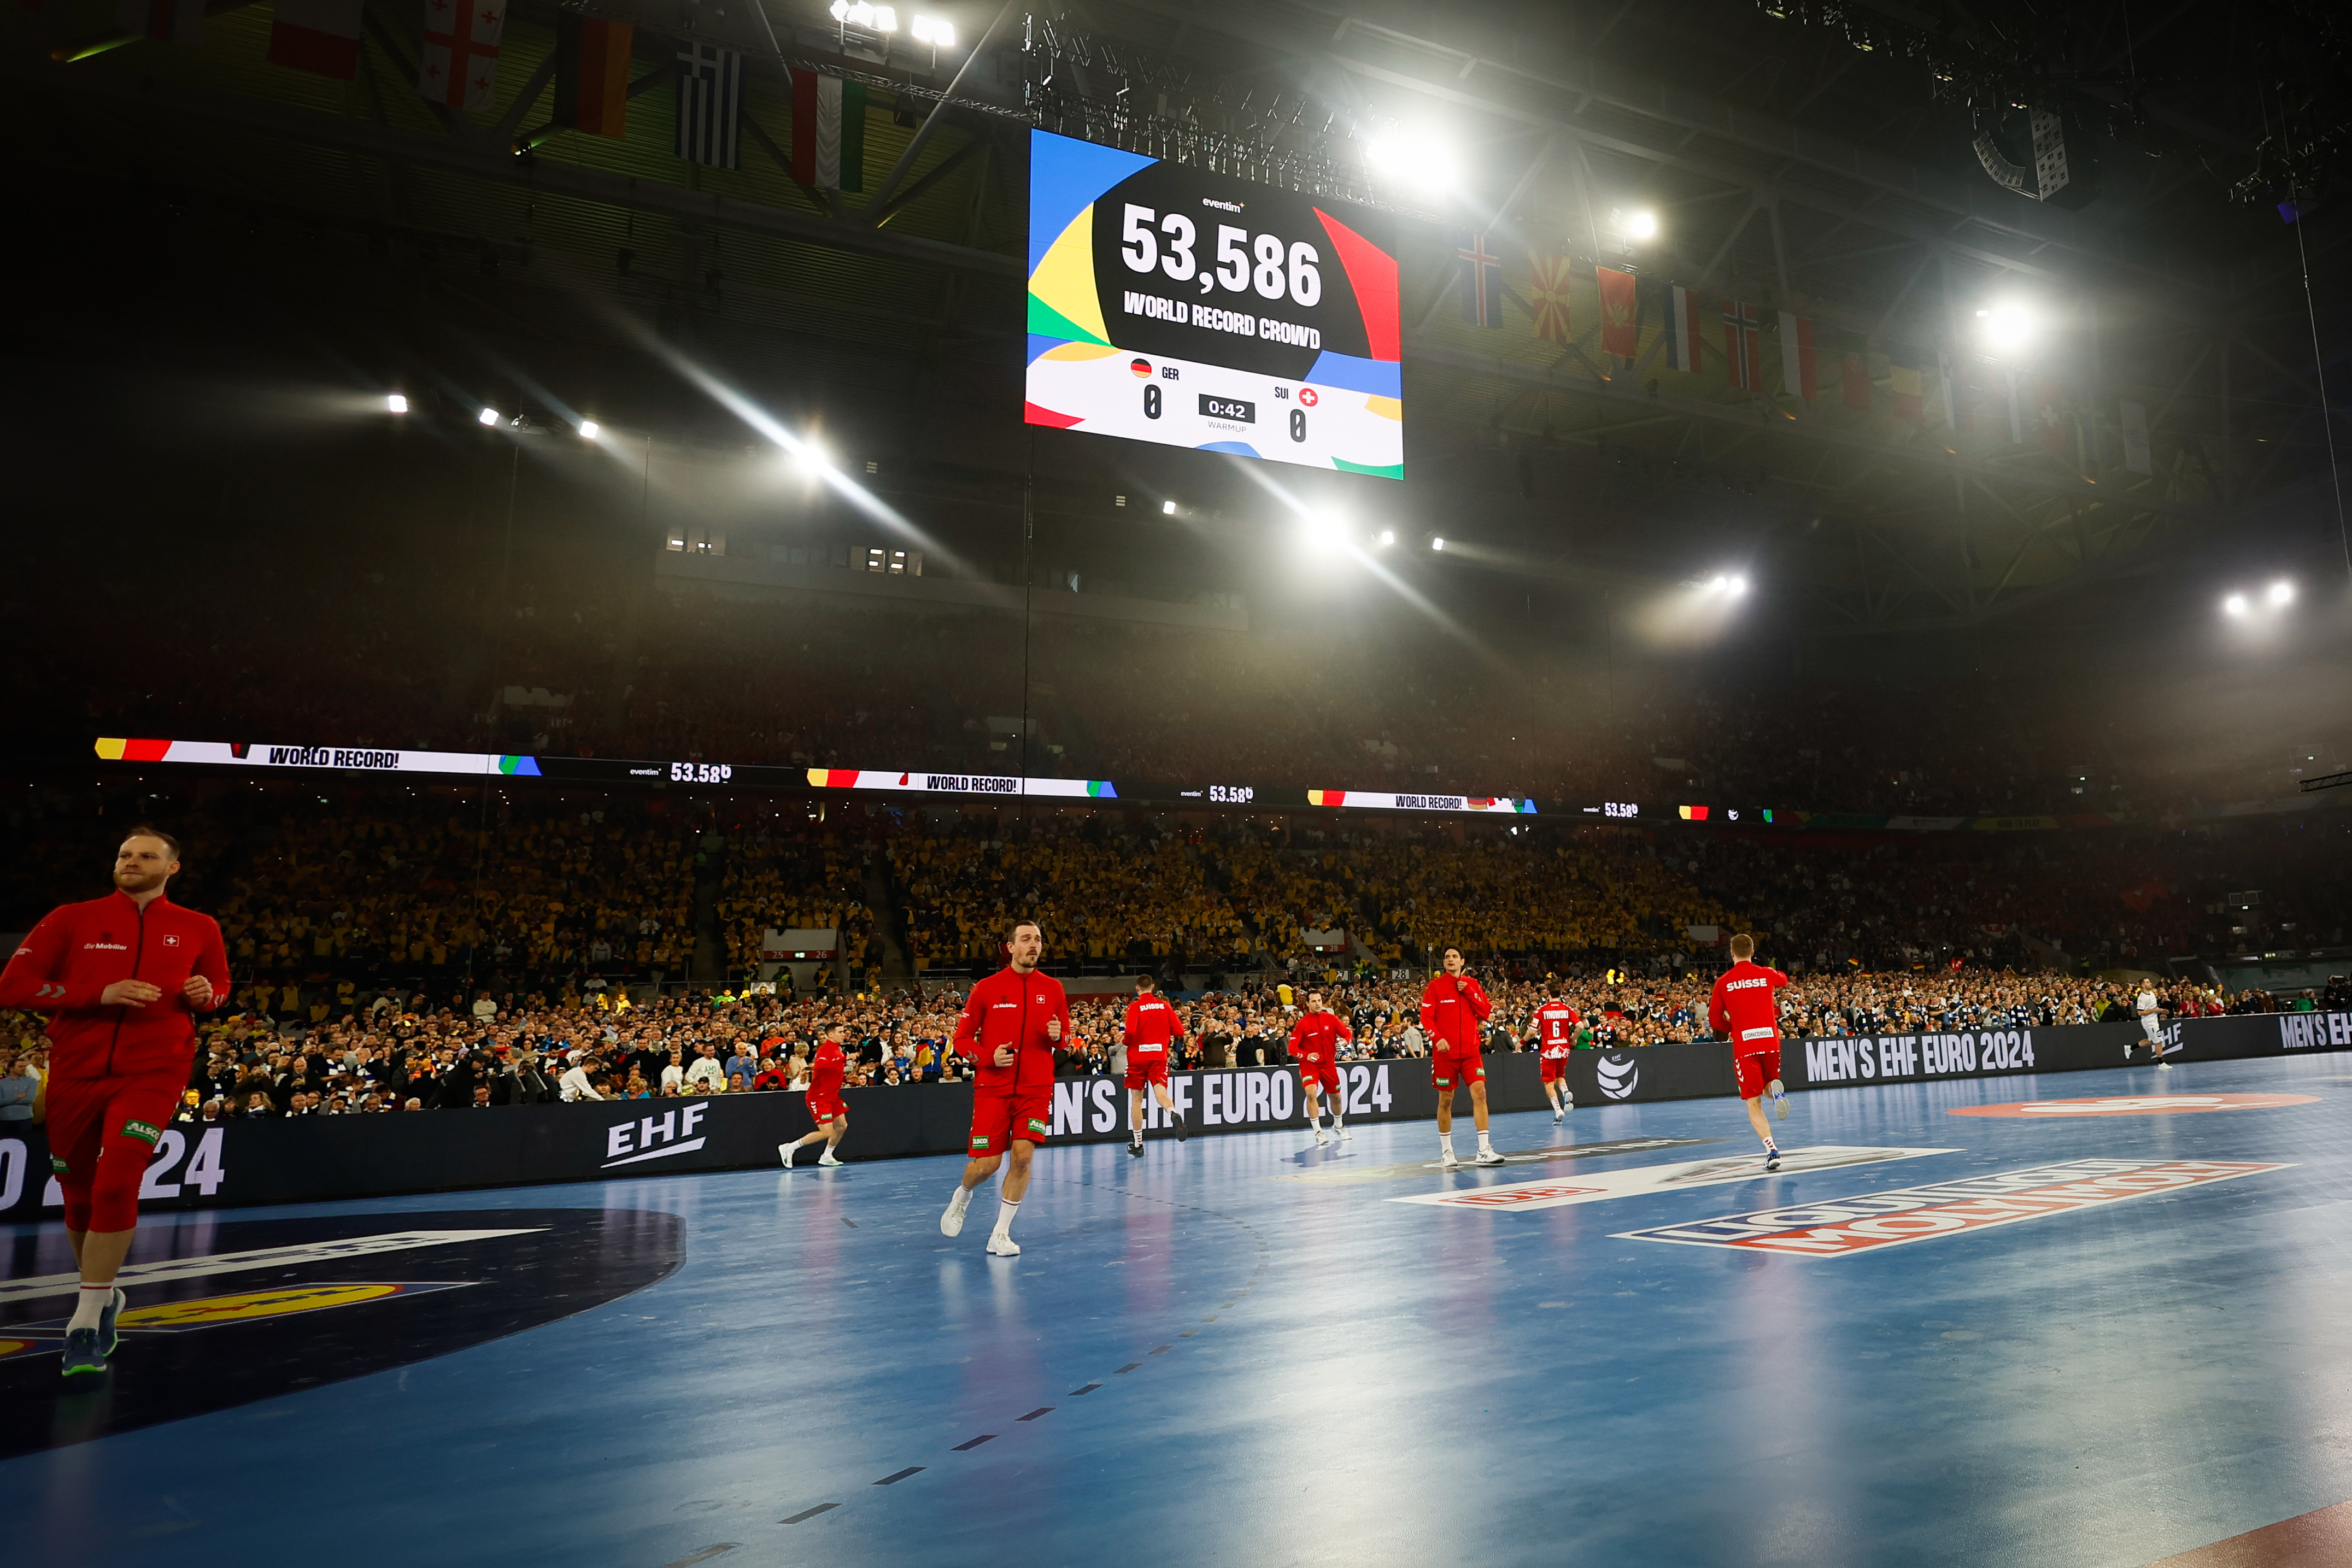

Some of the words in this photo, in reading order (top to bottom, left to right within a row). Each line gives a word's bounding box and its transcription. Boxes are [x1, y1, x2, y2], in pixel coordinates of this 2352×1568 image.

[1203, 197, 1241, 213] eventim
[1122, 203, 1322, 307] 53,586
[1124, 291, 1188, 324] WORLD
[1192, 303, 1256, 336] RECORD
[1259, 317, 1321, 349] CROWD
[1162, 367, 1179, 381] GER
[1274, 386, 1289, 400] SUI
[1208, 401, 1246, 419] 0:42
[1207, 421, 1247, 433] WARMUP
[269, 747, 329, 766] WORLD
[334, 749, 400, 769] RECORD!
[927, 775, 968, 790] WORLD
[972, 778, 1017, 793] RECORD!
[1396, 795, 1426, 808] WORLD
[1429, 797, 1462, 809] RECORD!
[1394, 970, 1406, 979] 28
[1542, 1010, 1569, 1020] TYNOWSKI
[1553, 1020, 1560, 1037] 6
[2279, 1014, 2327, 1048] MEN'S
[1805, 1038, 1875, 1082] MEN'S
[1879, 1036, 1917, 1077] EHF
[1922, 1032, 1976, 1074] EURO
[1980, 1030, 2034, 1070] 2024
[1045, 1079, 1116, 1136] N'S
[1203, 1070, 1293, 1125] EURO
[607, 1101, 708, 1158] EHF
[1929, 1160, 2167, 1194] LIQUI
[2024, 1162, 2260, 1199] MOLY
[1470, 1189, 1583, 1202] DB
[1653, 1196, 1961, 1241] LIQUI
[1749, 1199, 2054, 1250] MOLY
